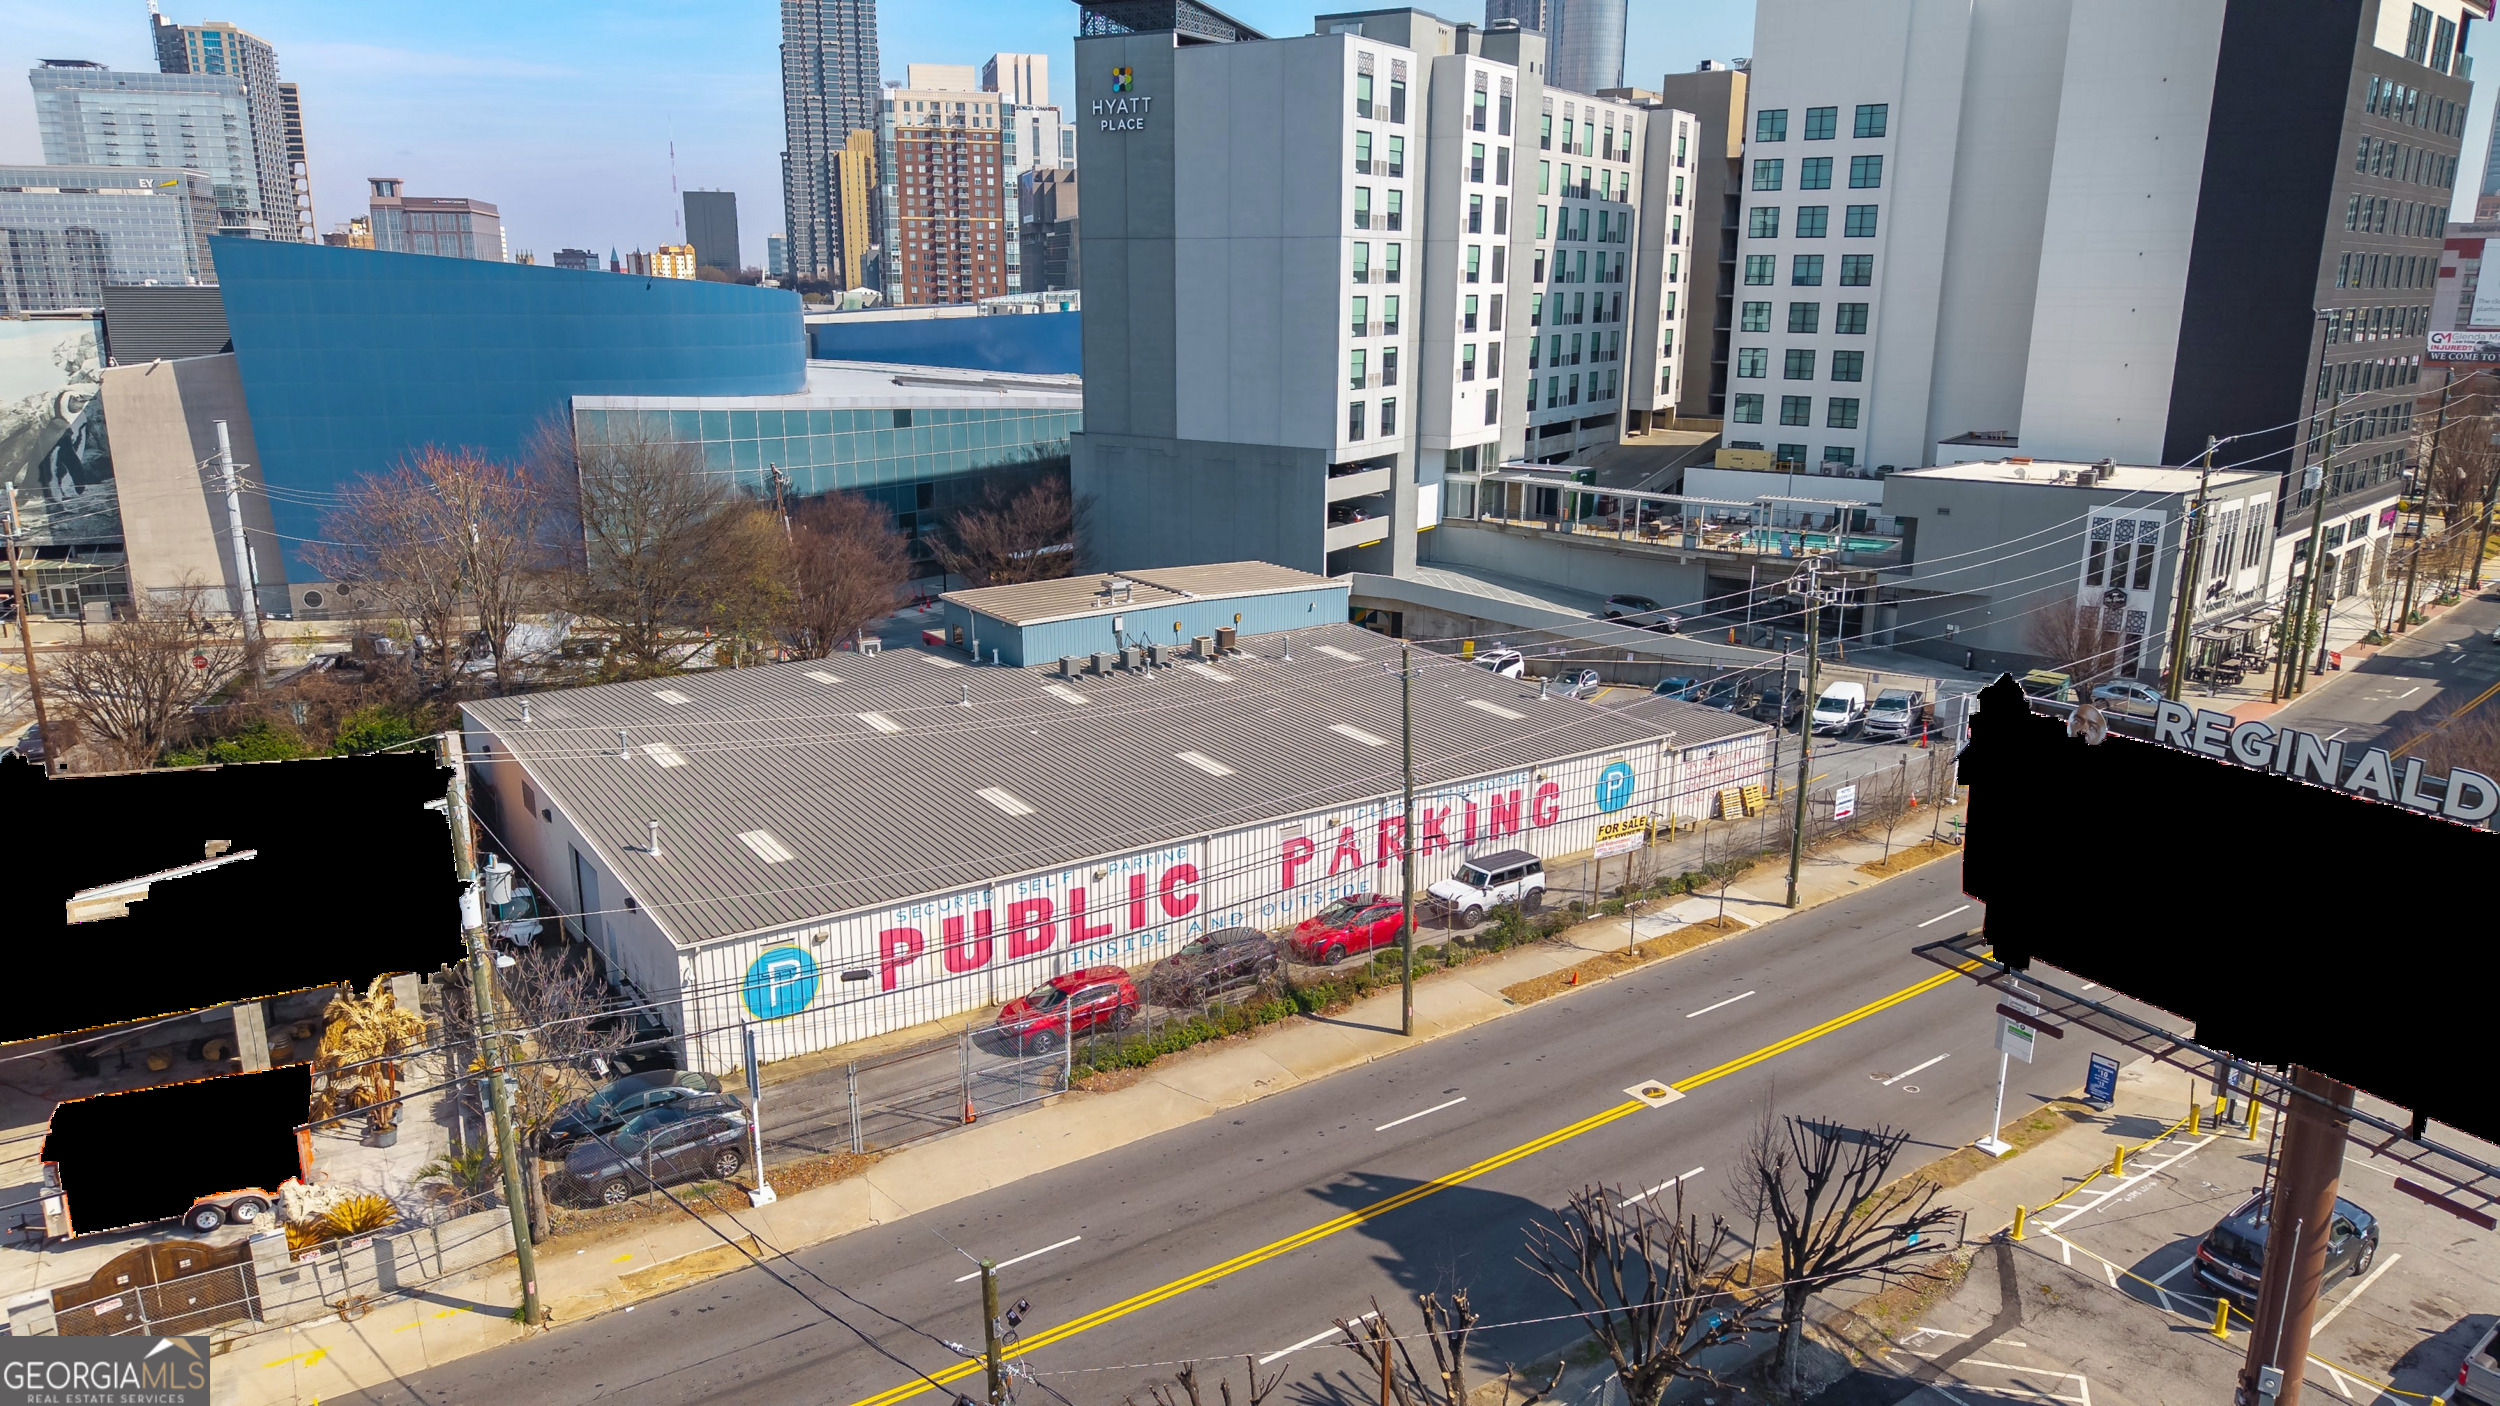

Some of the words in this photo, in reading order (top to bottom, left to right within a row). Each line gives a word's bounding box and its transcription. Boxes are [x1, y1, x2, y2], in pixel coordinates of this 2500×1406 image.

[1092, 97, 1152, 115] HYATT
[1101, 118, 1144, 131] PLACE
[139, 179, 154, 188] EY
[2153, 700, 2500, 822] REGINALD
[1607, 771, 1624, 803] P
[1599, 823, 1619, 836] FOR
[1622, 816, 1645, 831] SALE
[879, 863, 1200, 992] PUBLIC
[1281, 781, 1560, 890] PARKING
[896, 890, 994, 923] SECURED
[1018, 871, 1074, 895] SELF
[1109, 847, 1188, 876] PARKING
[1070, 929, 1169, 966] INSIDE
[1188, 911, 1244, 936] AND
[1262, 879, 1370, 917] OUTSIDE
[767, 959, 802, 1008] P
